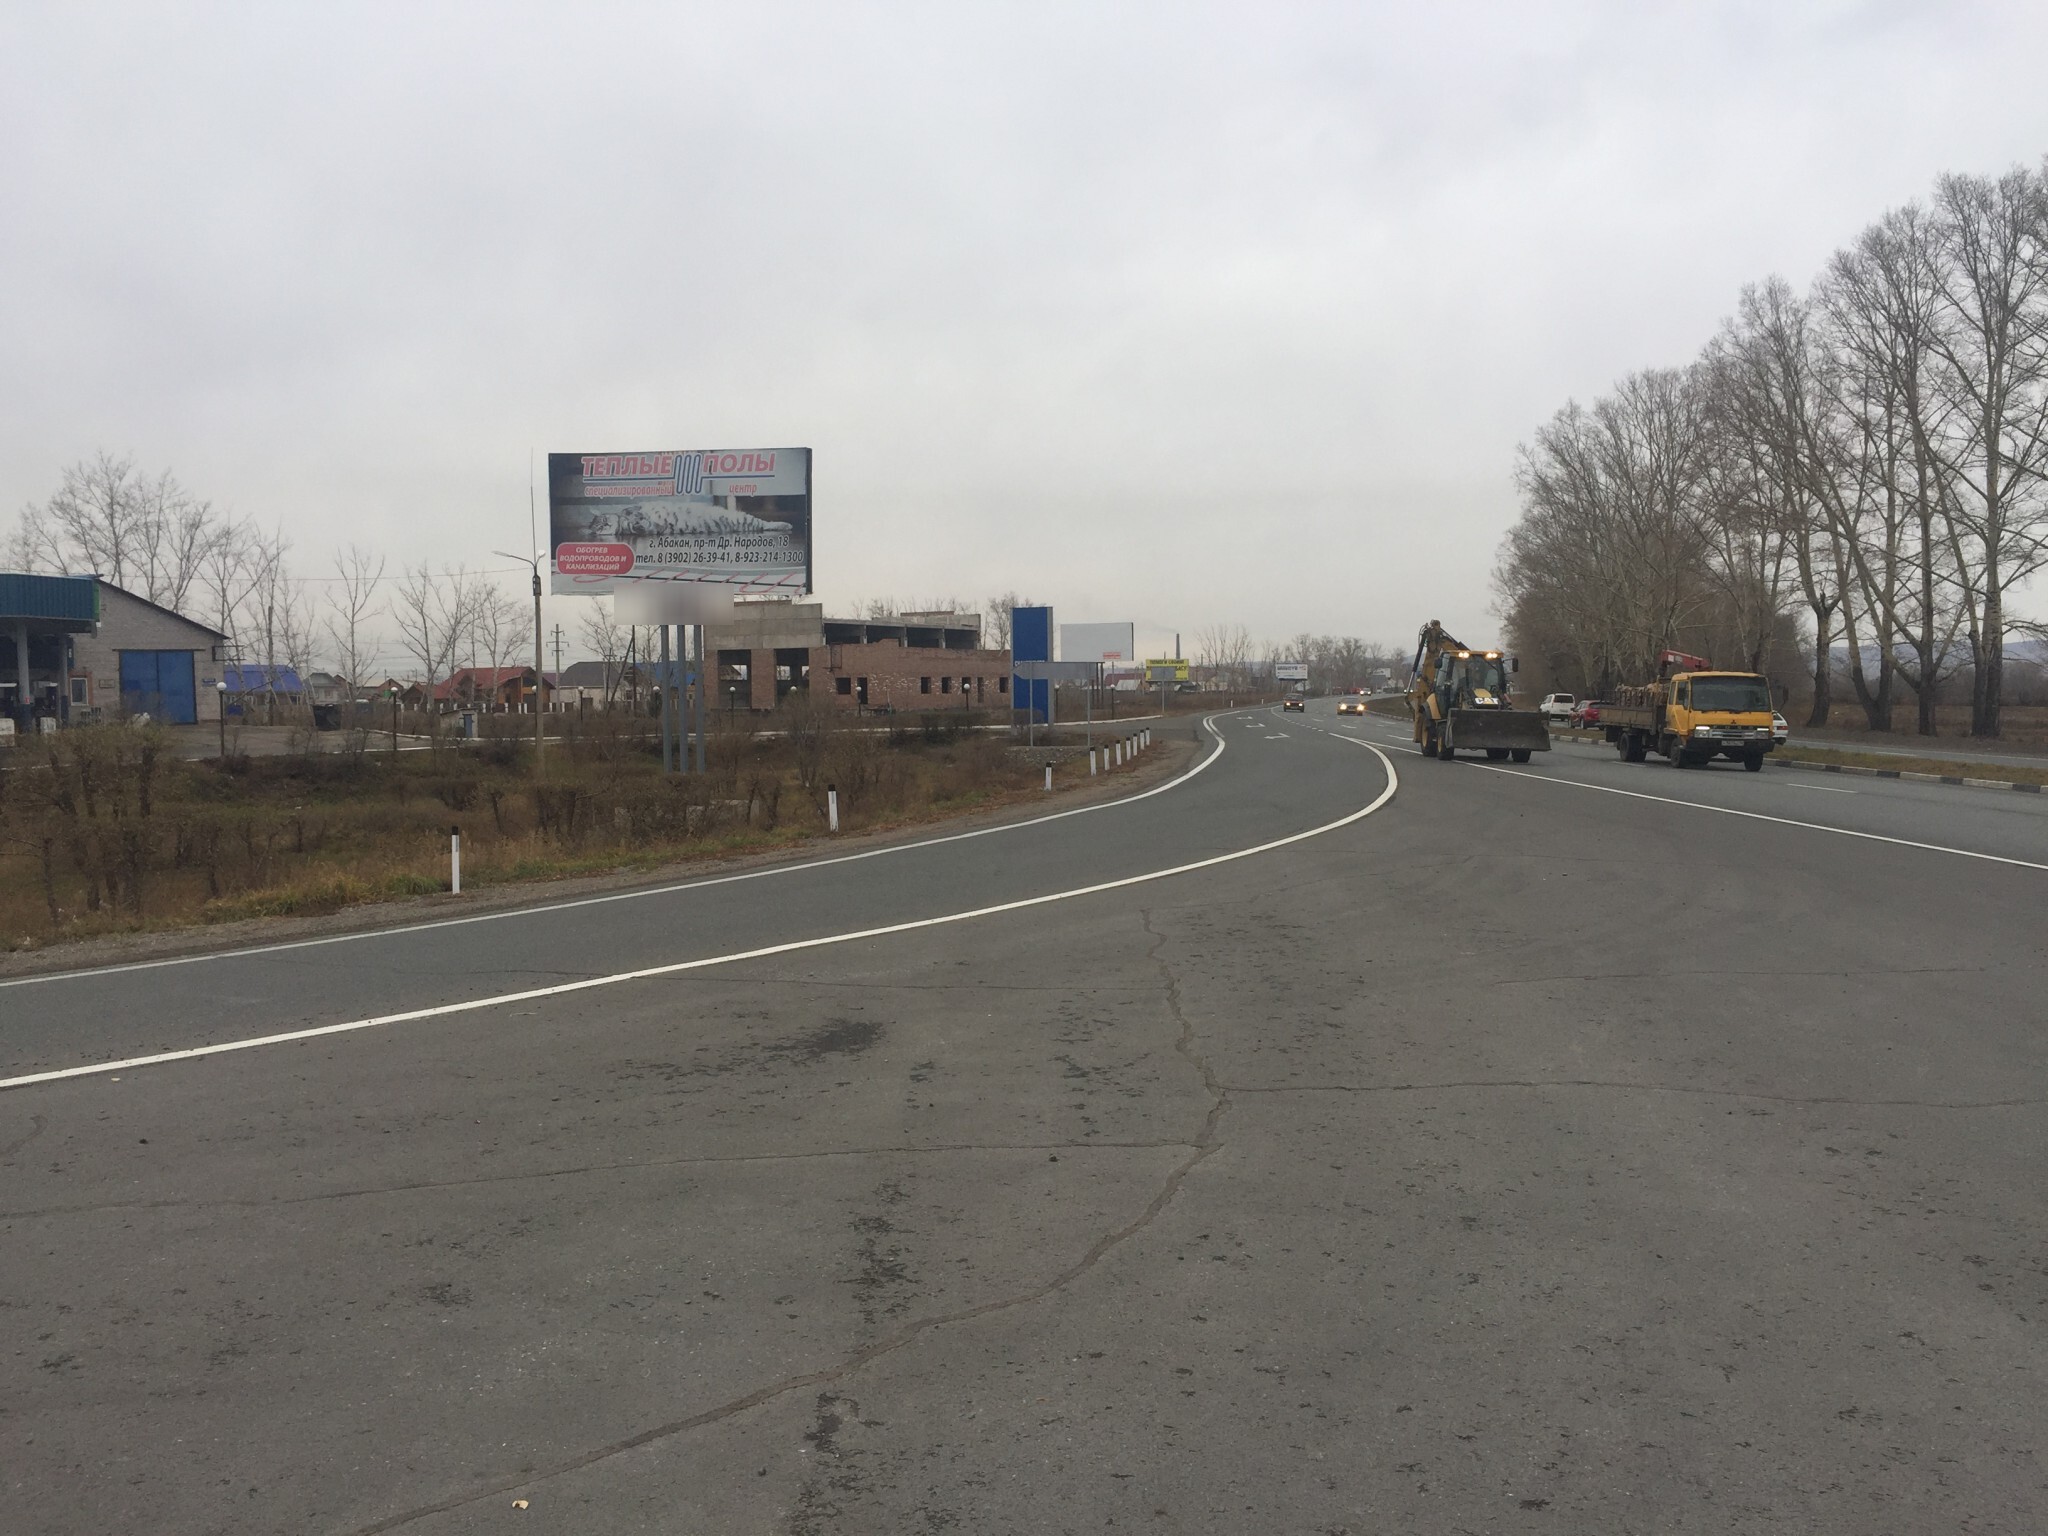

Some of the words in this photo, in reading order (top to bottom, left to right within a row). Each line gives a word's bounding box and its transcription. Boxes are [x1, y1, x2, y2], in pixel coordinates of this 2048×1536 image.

[581, 455, 673, 476] ТЕПЛЫЕ
[703, 453, 776, 473] ПОЛЫ
[585, 485, 673, 498] специализированный
[729, 484, 758, 496] центр
[649, 539, 656, 548] г.
[658, 536, 692, 549] Абакан,
[694, 539, 716, 550] пр-т
[717, 537, 732, 550] Др.
[734, 535, 776, 549] Народов,
[778, 536, 789, 547] 18
[559, 555, 620, 563] ВОДОПРОВОДОВ
[636, 554, 656, 564] тел.
[658, 553, 663, 563] 8
[665, 552, 691, 564] (3902)
[693, 552, 733, 564] 26-39-41,
[735, 551, 804, 563] 8-923-214-1300
[566, 562, 620, 571] КАНАЛИЗАЦИЙ
[1475, 697, 1499, 705] CAT
